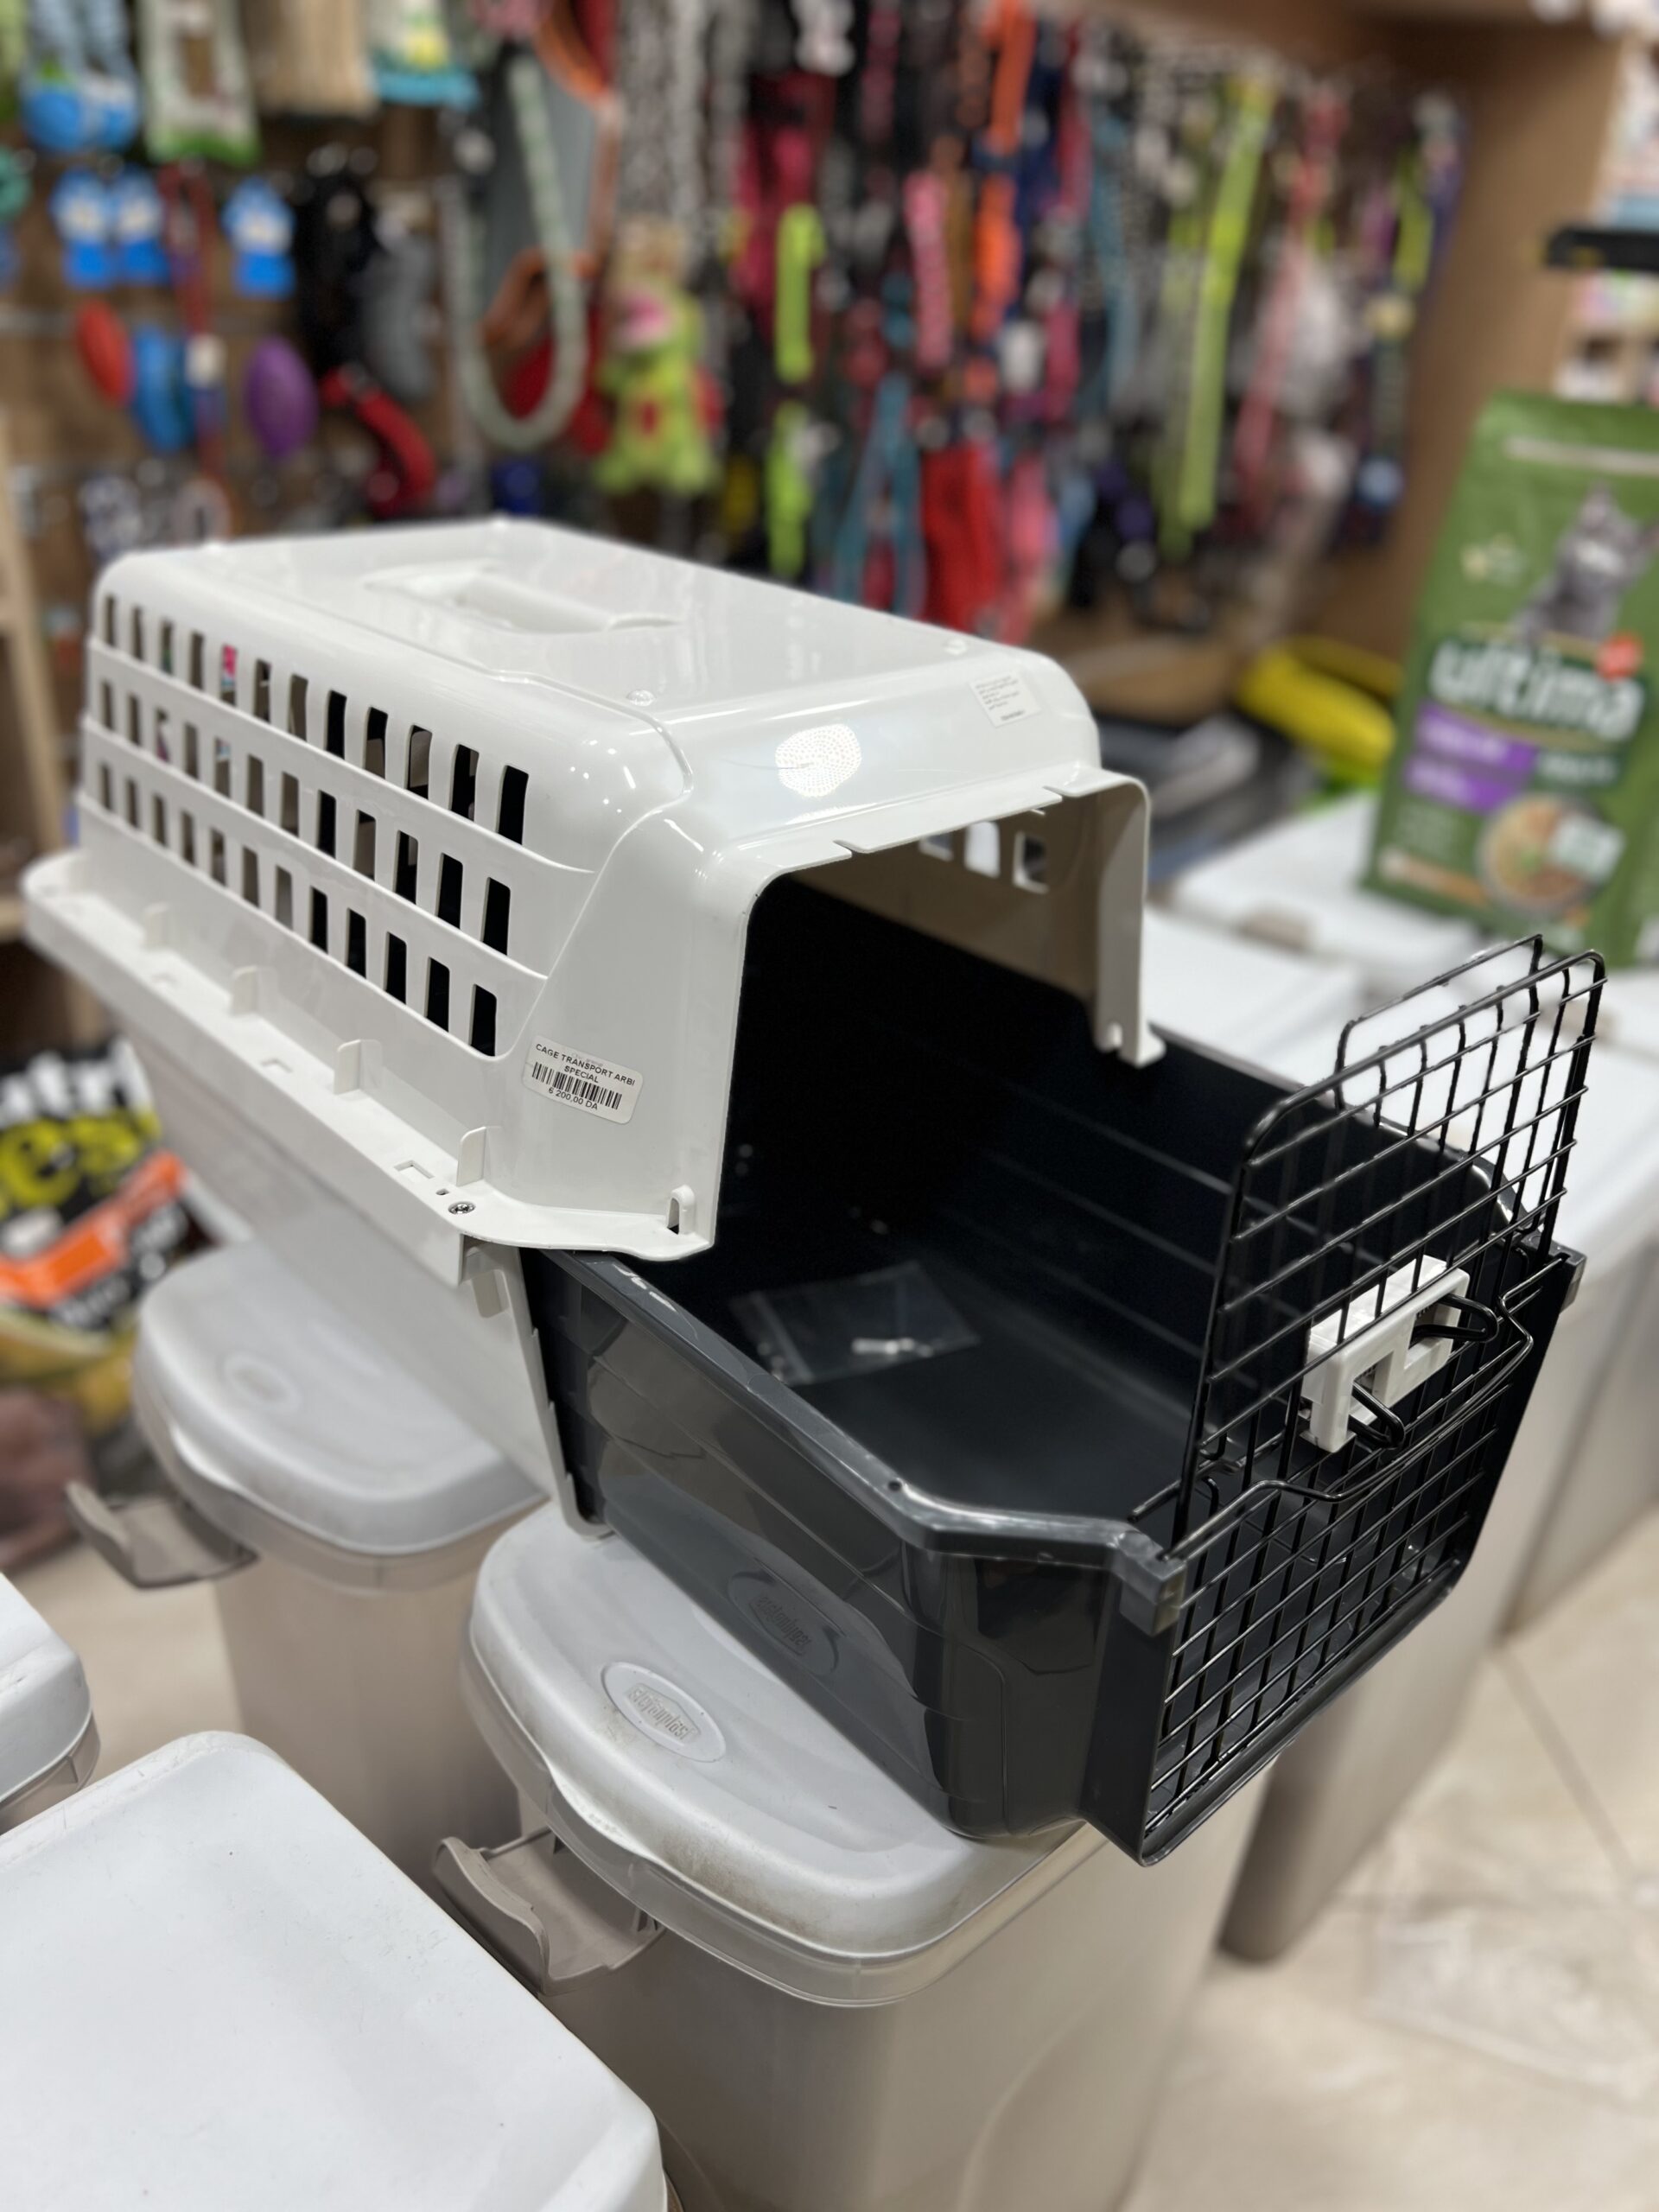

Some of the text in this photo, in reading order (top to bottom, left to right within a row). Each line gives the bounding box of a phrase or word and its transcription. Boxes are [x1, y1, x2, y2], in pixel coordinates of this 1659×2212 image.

[536, 1044, 559, 1059] CAGE
[562, 1054, 613, 1077] TRANSPORT
[614, 1073, 635, 1086] ARBI
[564, 1065, 599, 1084] SPECIAL
[556, 1091, 584, 1105] 200,00
[585, 1101, 598, 1110] DA
